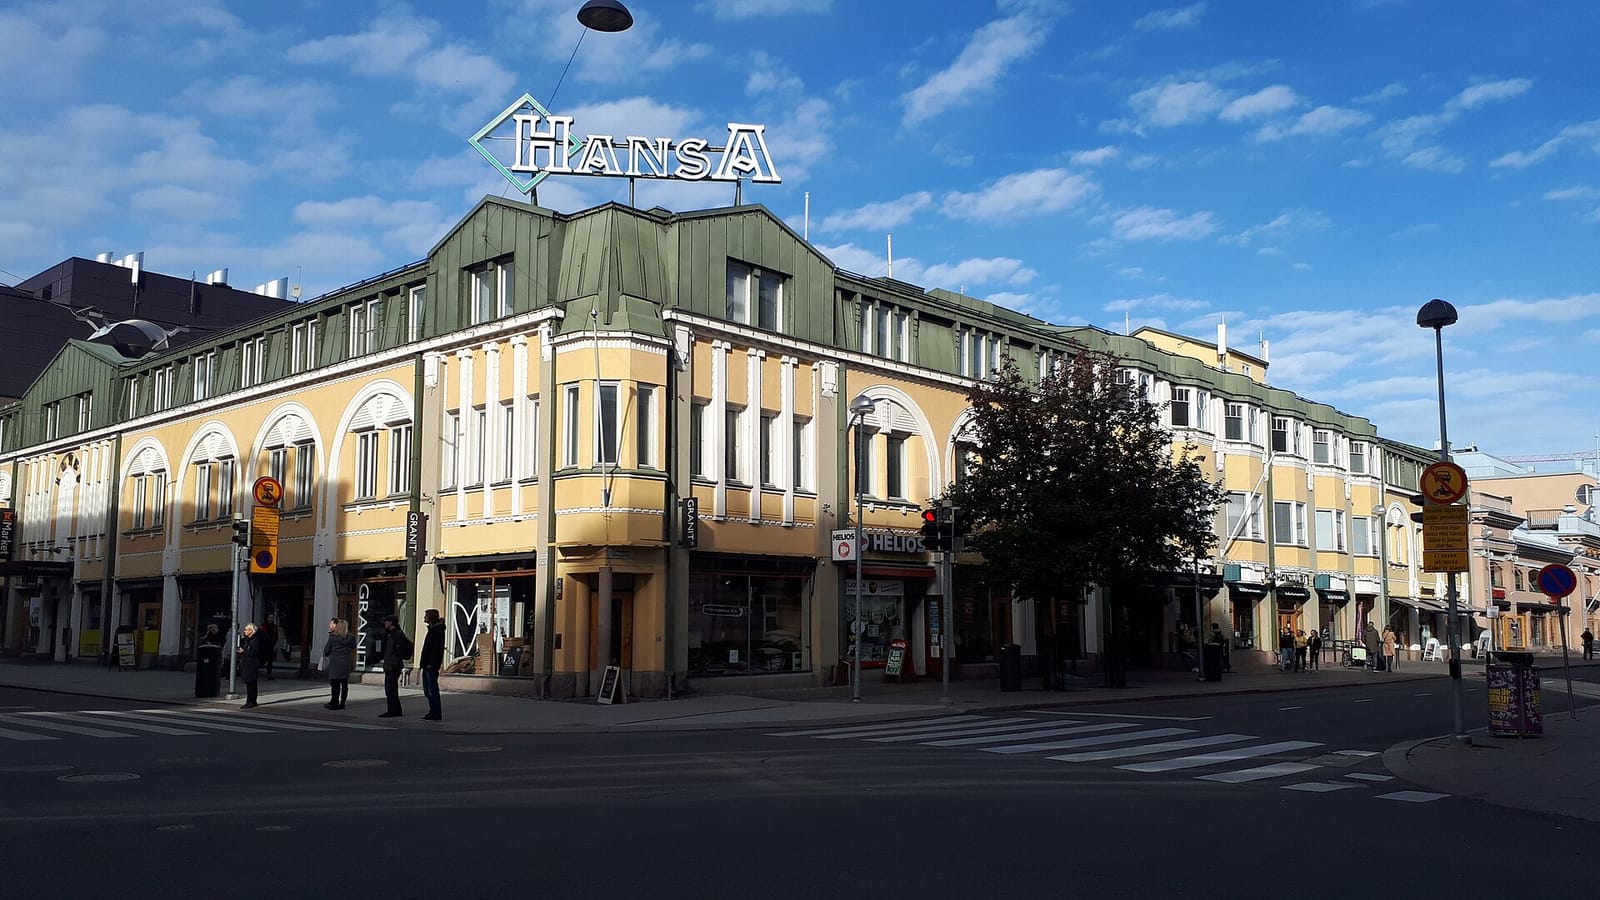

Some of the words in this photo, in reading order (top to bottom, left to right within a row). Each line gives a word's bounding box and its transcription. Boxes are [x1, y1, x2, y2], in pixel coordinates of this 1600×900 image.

[511, 114, 782, 183] HANSA
[1, 521, 13, 555] Market
[408, 512, 418, 552] GRANIT
[685, 497, 696, 541] GRANIT
[833, 533, 854, 541] HELIOS
[873, 534, 926, 553] HELIOS
[356, 583, 370, 672] GRANIT
